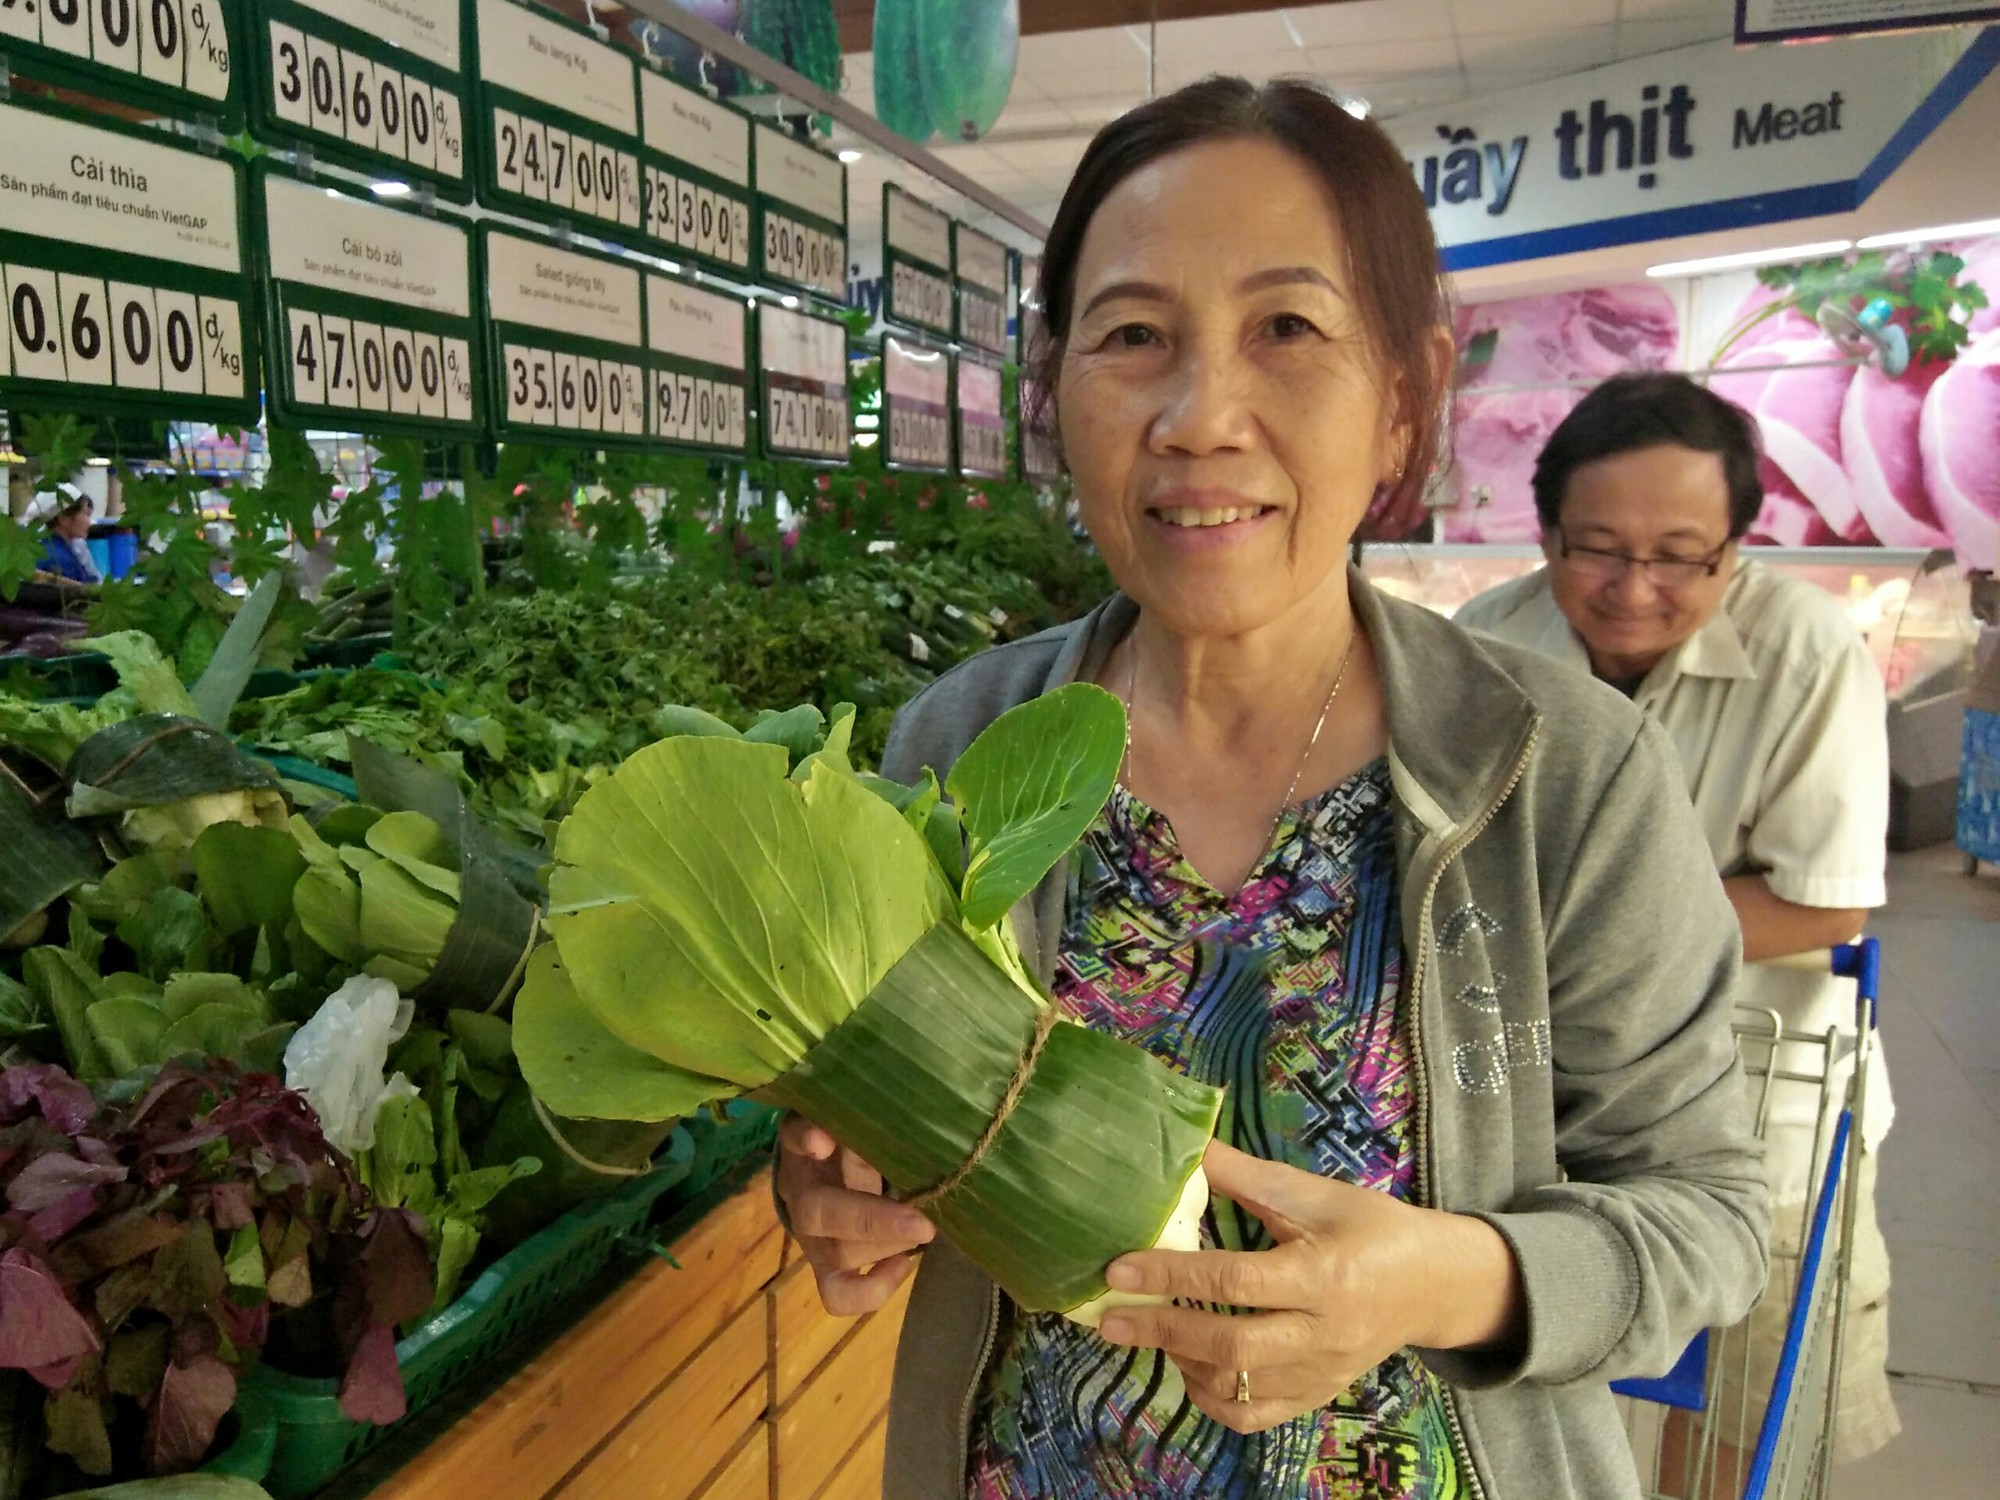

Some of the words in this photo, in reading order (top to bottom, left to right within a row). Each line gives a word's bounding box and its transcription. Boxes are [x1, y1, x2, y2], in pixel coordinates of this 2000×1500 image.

[280, 42, 429, 145] 30.600
[502, 125, 613, 201] 24.700
[1555, 84, 1697, 190] thịt
[1733, 91, 1846, 149] Meat
[0, 174, 27, 192] Sản
[96, 196, 119, 213] tiêu
[161, 211, 208, 230] VietGAP
[70, 155, 104, 182] Cải
[111, 165, 148, 192] thìa
[646, 178, 729, 245] 23.300
[768, 223, 835, 277] 30.900
[297, 324, 438, 397] 47.000
[513, 358, 622, 415] 35.600
